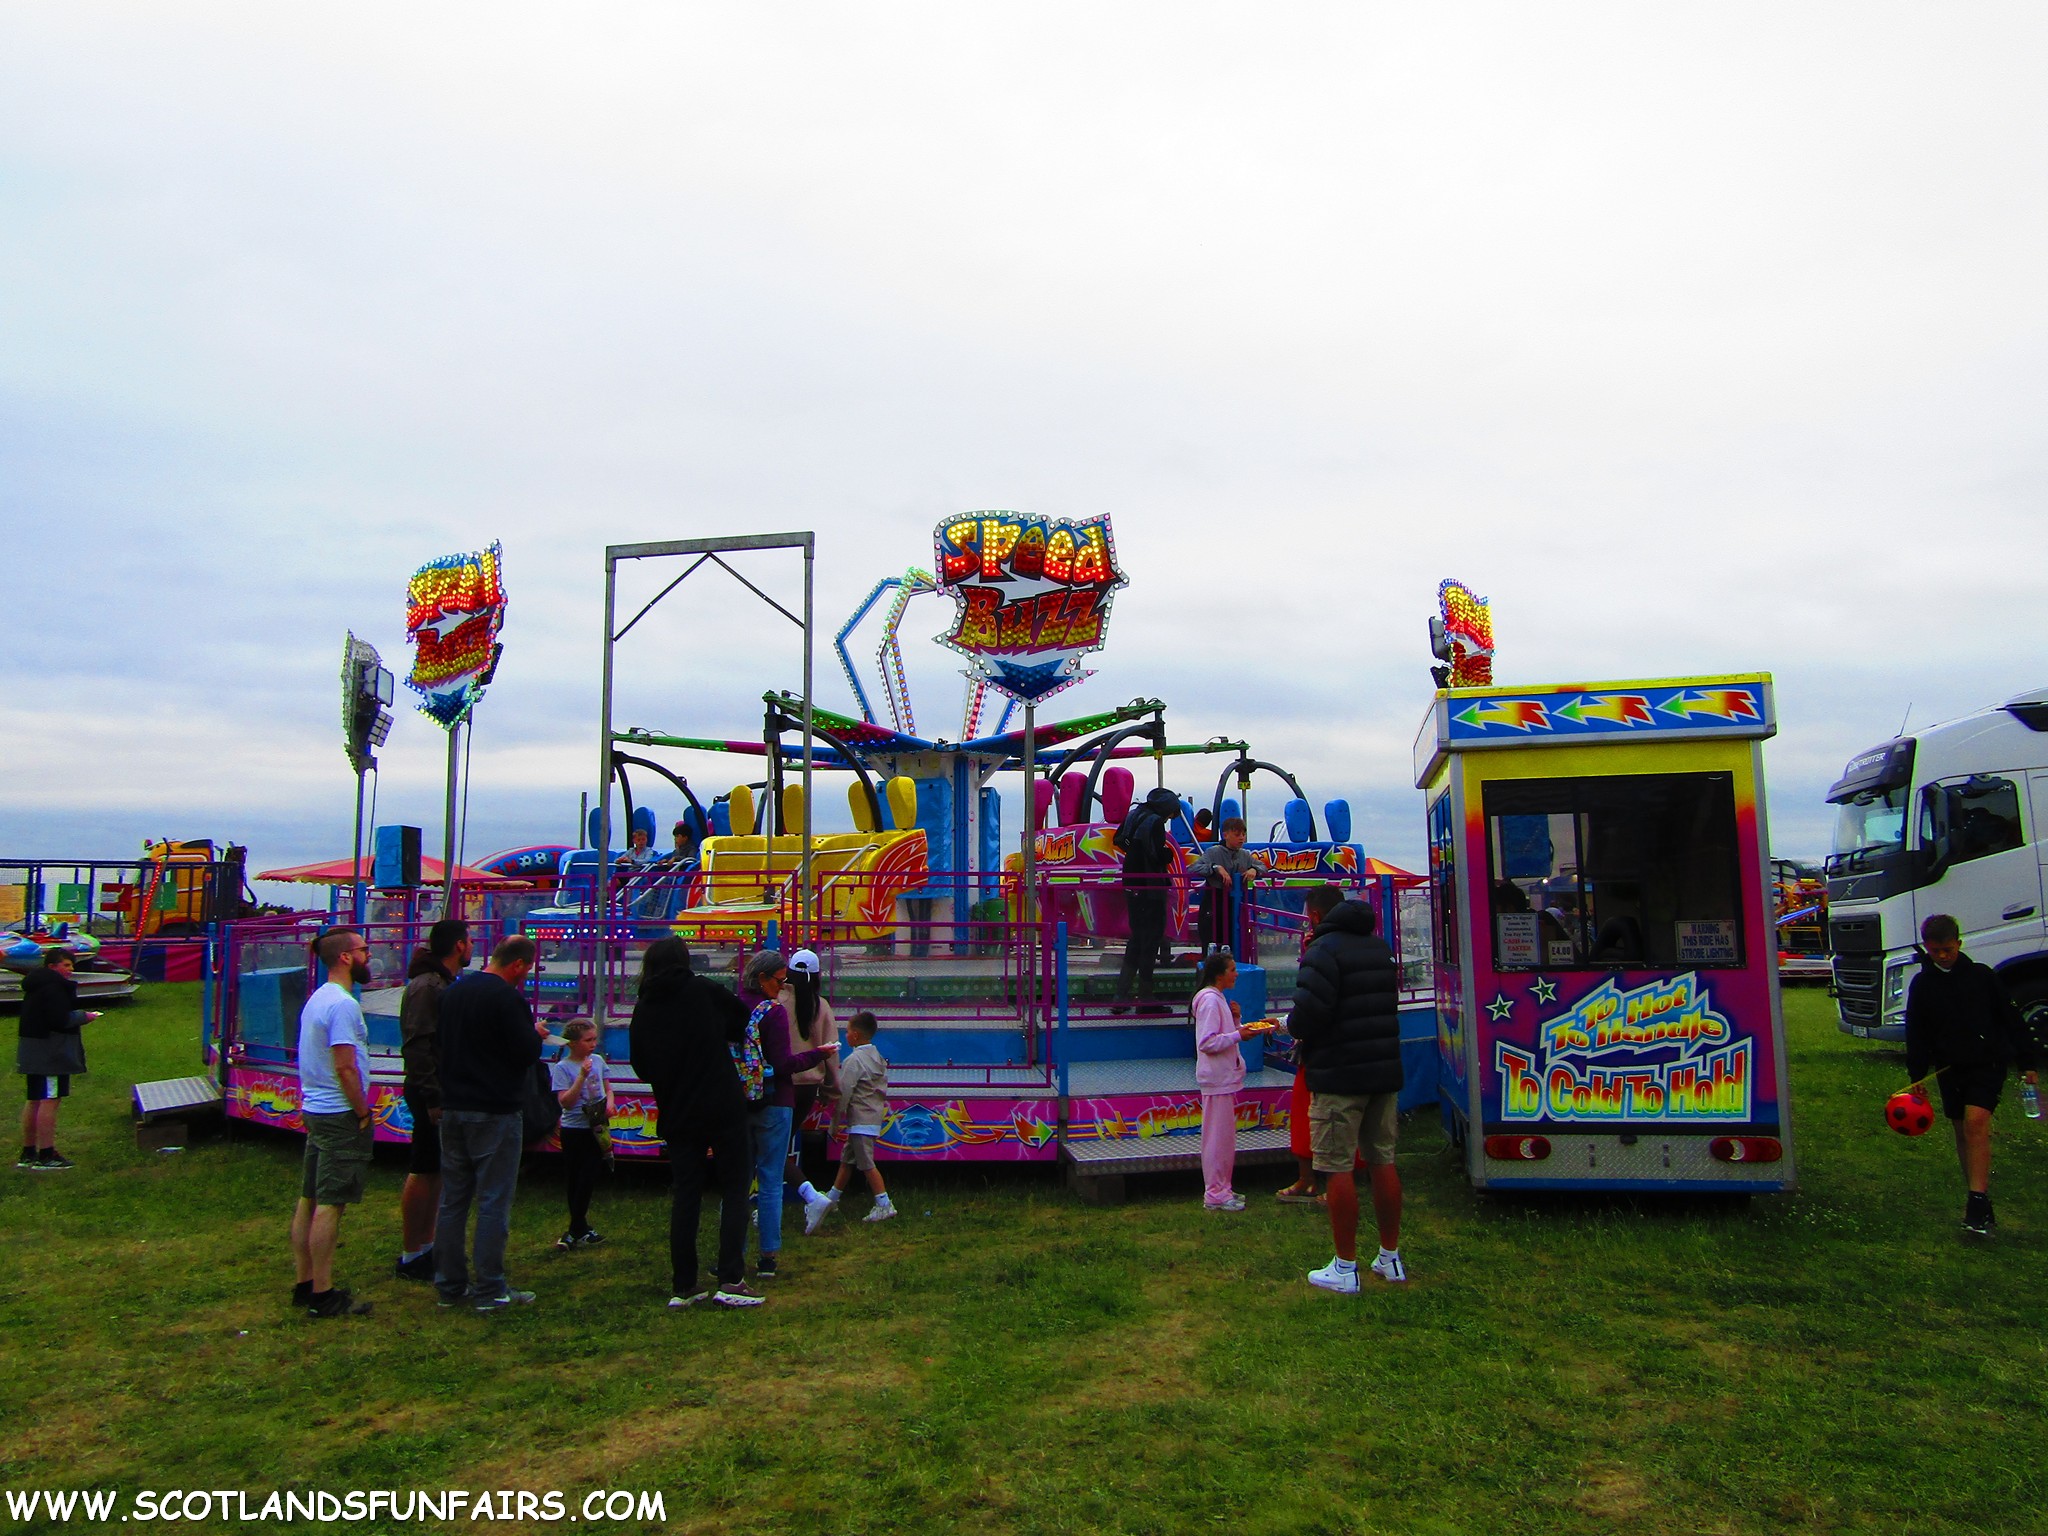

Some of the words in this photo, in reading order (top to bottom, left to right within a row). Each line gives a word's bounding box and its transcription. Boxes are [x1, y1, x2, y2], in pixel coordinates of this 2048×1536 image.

[1549, 1021, 1590, 1050] To
[1595, 1010, 1724, 1048] Handle
[1579, 994, 1618, 1030] To
[1626, 983, 1688, 1025] Hot
[1502, 1051, 1539, 1113] To
[1549, 1067, 1624, 1113] Cold
[1625, 1074, 1664, 1113] To
[1668, 1049, 1746, 1114] Hold
